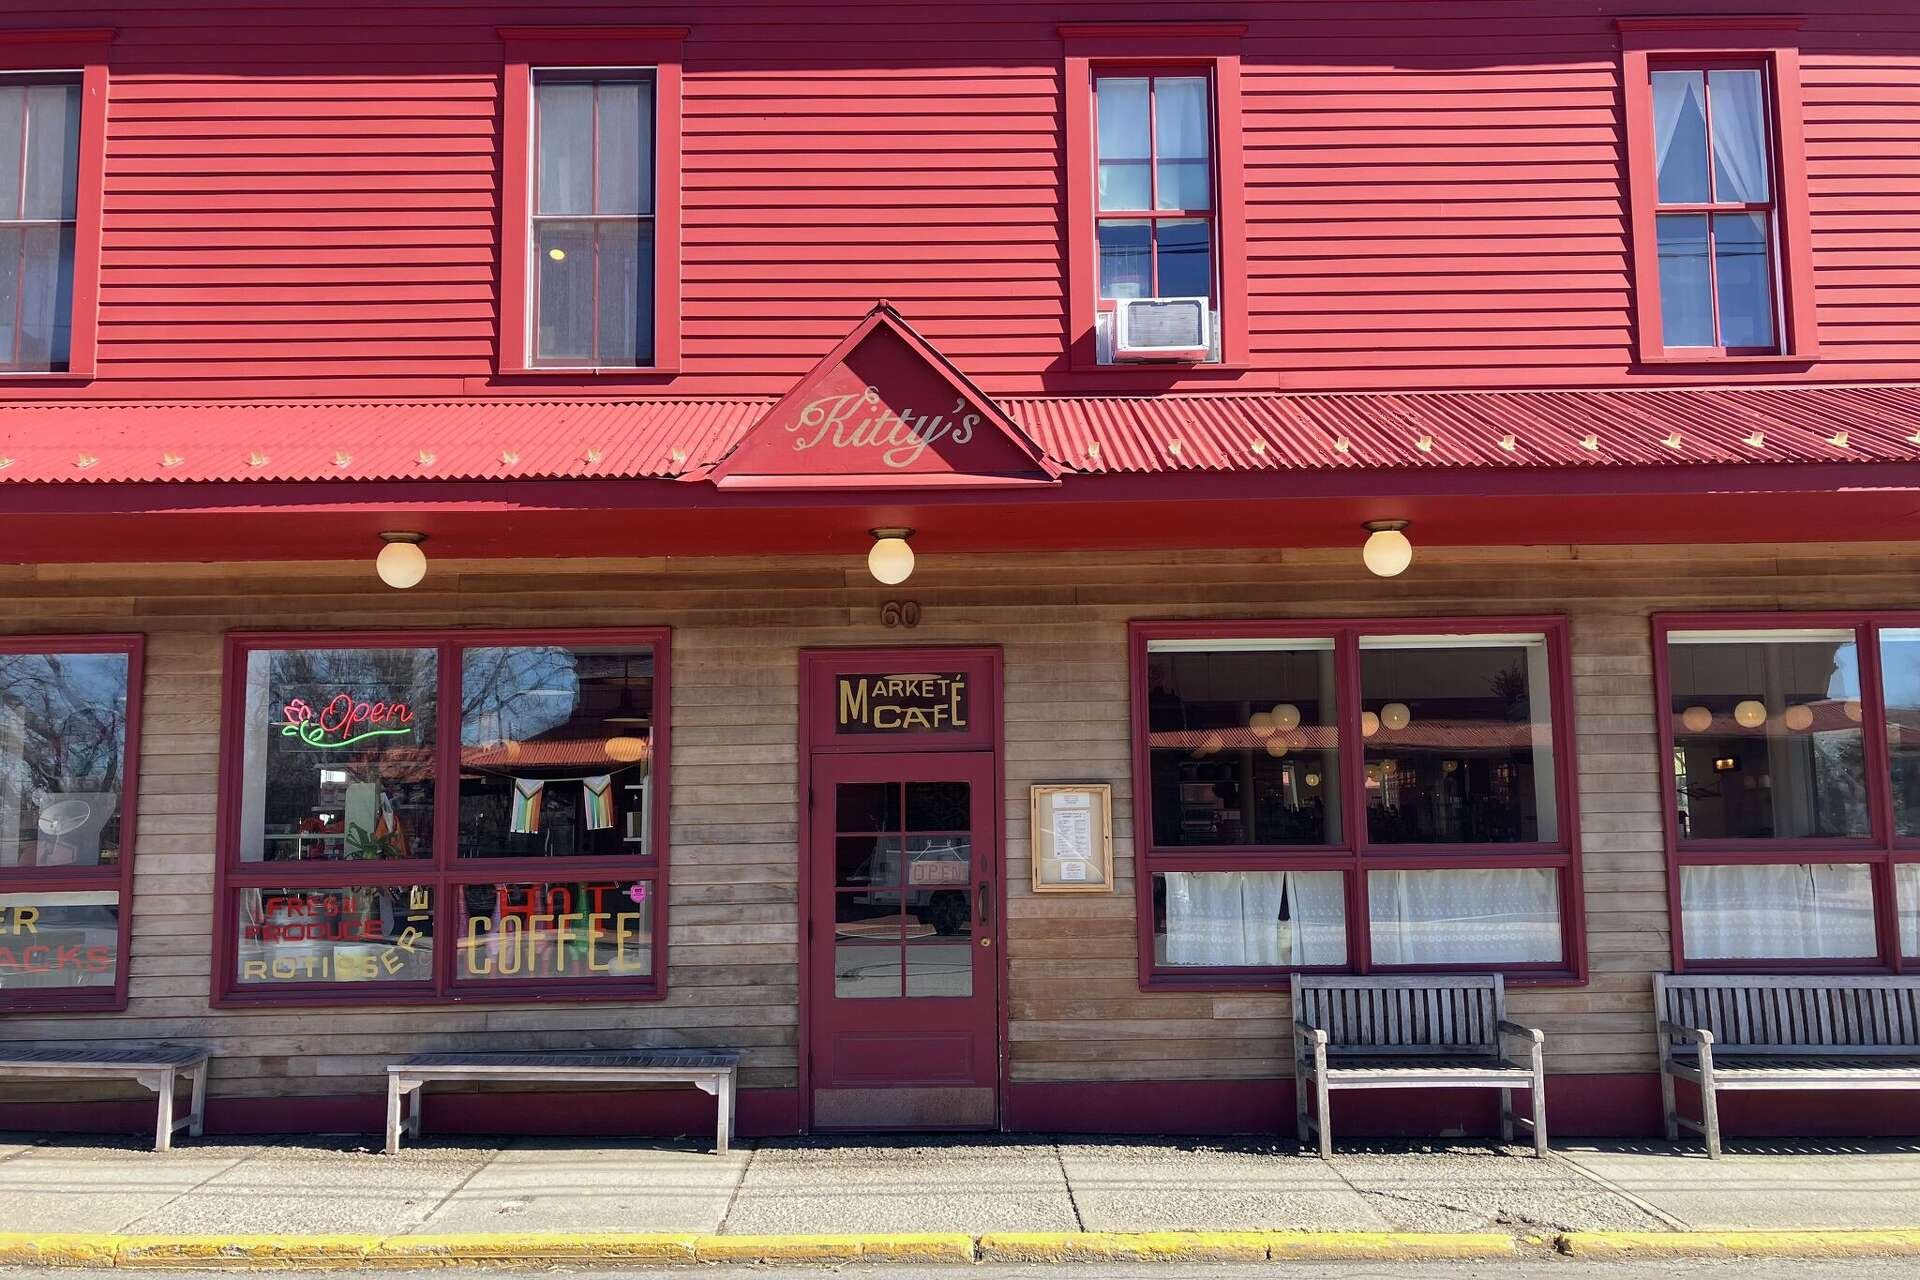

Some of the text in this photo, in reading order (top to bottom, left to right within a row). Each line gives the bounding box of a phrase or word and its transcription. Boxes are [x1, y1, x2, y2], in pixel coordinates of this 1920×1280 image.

[785, 386, 980, 468] Kitty's
[880, 600, 921, 628] 60
[320, 694, 414, 740] Open
[914, 863, 961, 881] OPEN
[244, 919, 384, 945] PRODUCE
[499, 886, 618, 934] HOT
[467, 911, 642, 975] COFFEE
